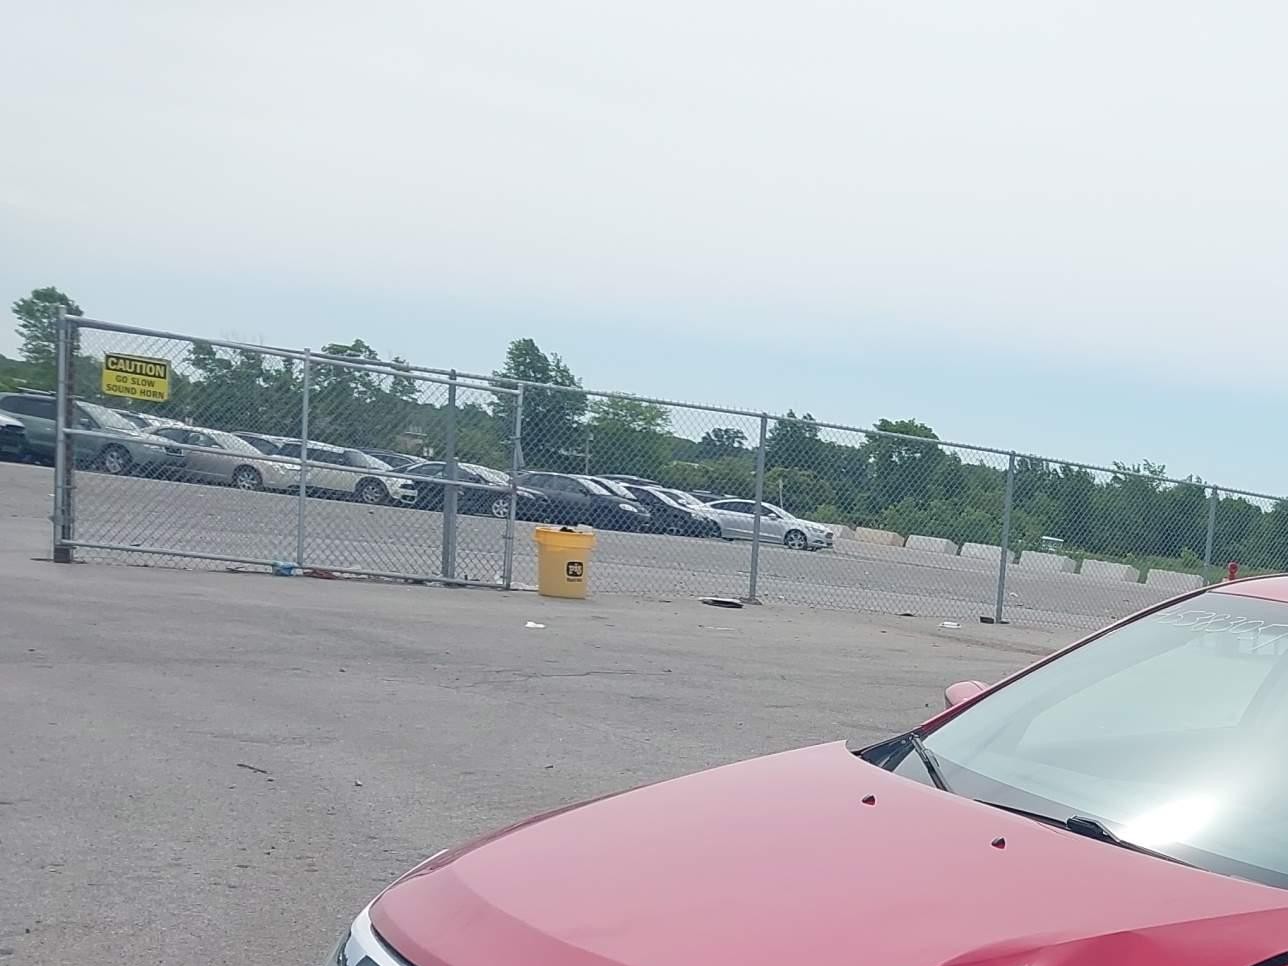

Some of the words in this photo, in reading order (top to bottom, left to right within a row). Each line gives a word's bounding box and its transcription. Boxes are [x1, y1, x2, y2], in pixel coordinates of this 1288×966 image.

[107, 357, 165, 377] CAUTION
[115, 375, 128, 383] GO
[131, 377, 155, 387] SLOW
[106, 384, 137, 394] SOUND
[140, 389, 165, 399] HORN
